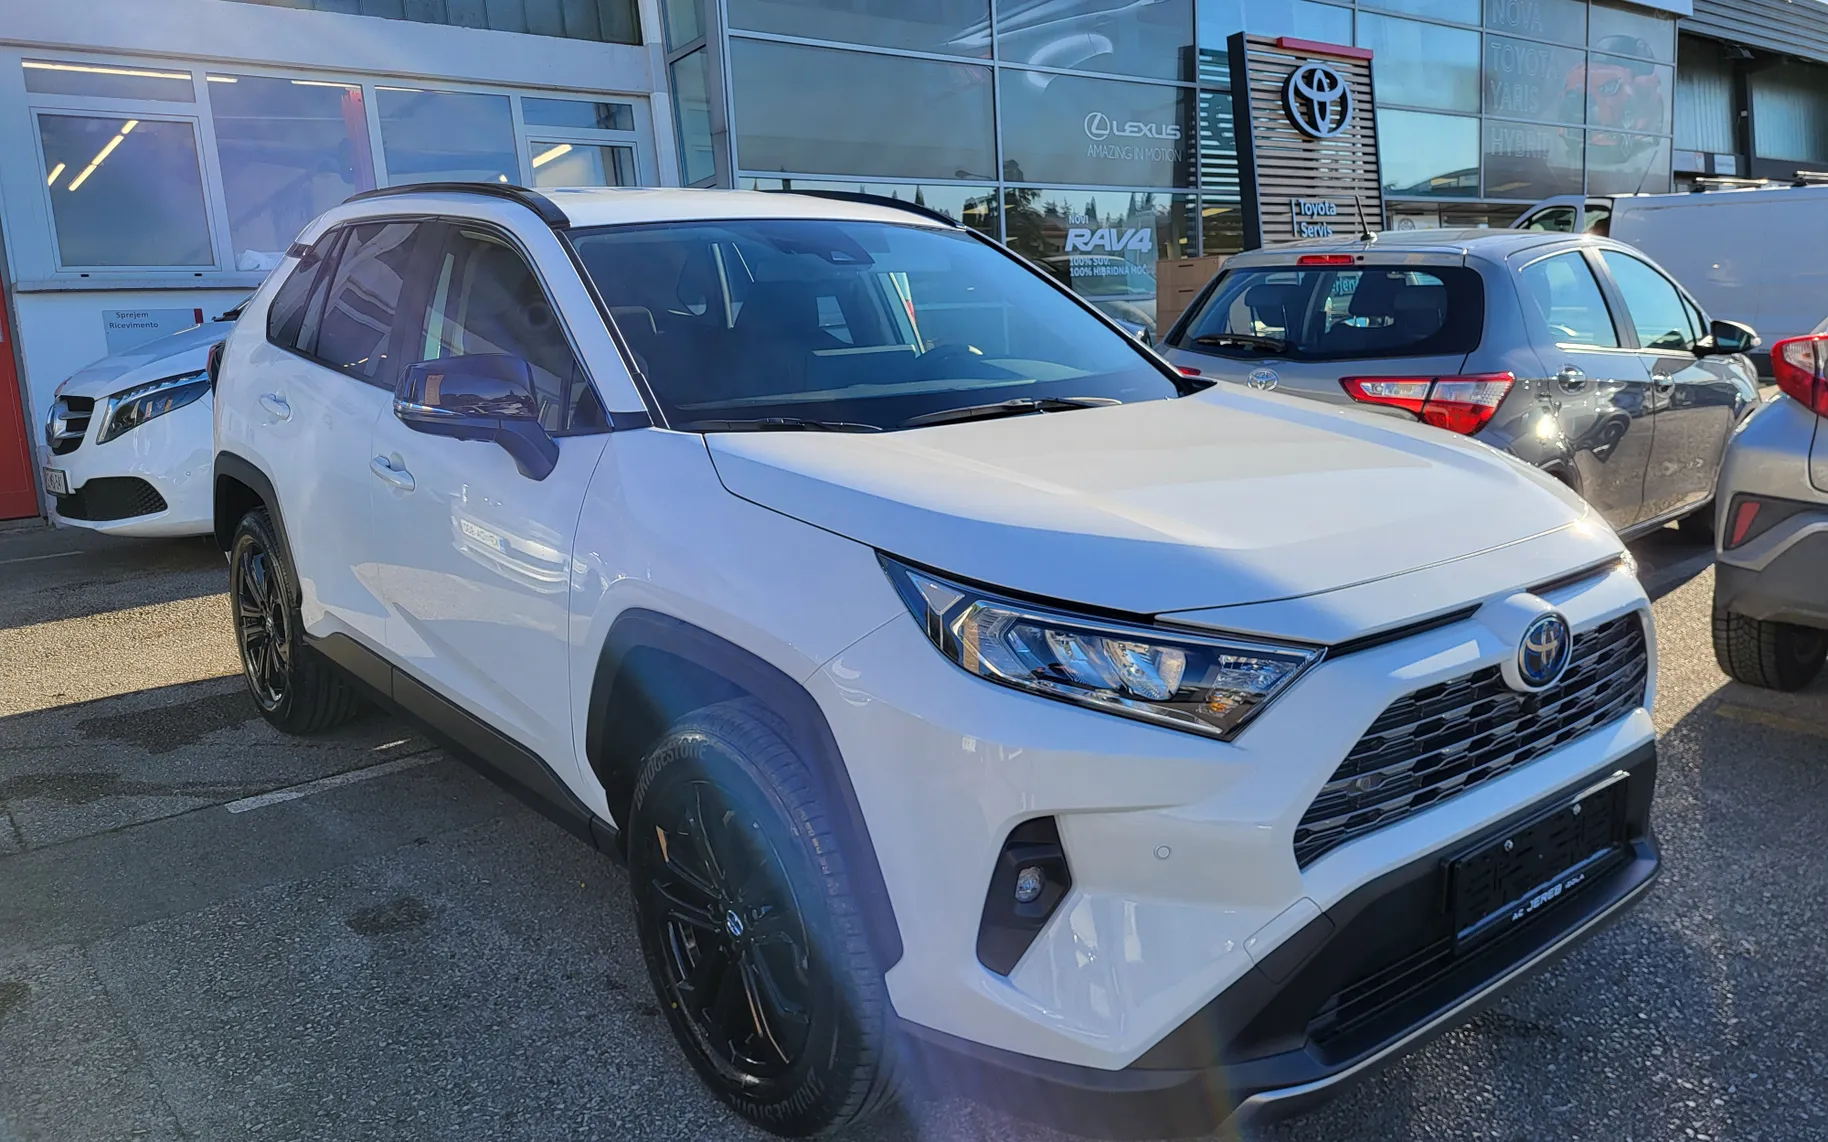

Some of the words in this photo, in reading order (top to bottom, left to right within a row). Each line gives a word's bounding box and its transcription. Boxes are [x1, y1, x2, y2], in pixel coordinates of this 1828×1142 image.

[1492, 0, 1543, 31] NOVA
[1491, 43, 1558, 79] TOYOTA
[1490, 80, 1538, 113] YARIS
[1113, 120, 1181, 140] LEXUS
[1087, 144, 1132, 160] AMAZING
[1133, 147, 1144, 160] IN
[1145, 148, 1182, 162] MOTION
[1299, 200, 1337, 218] Toyota
[1069, 215, 1089, 224] NOVI
[1301, 223, 1333, 237] Servis
[1065, 228, 1152, 252] RAV4
[1070, 257, 1092, 266] 100%
[1070, 267, 1093, 276] 100%
